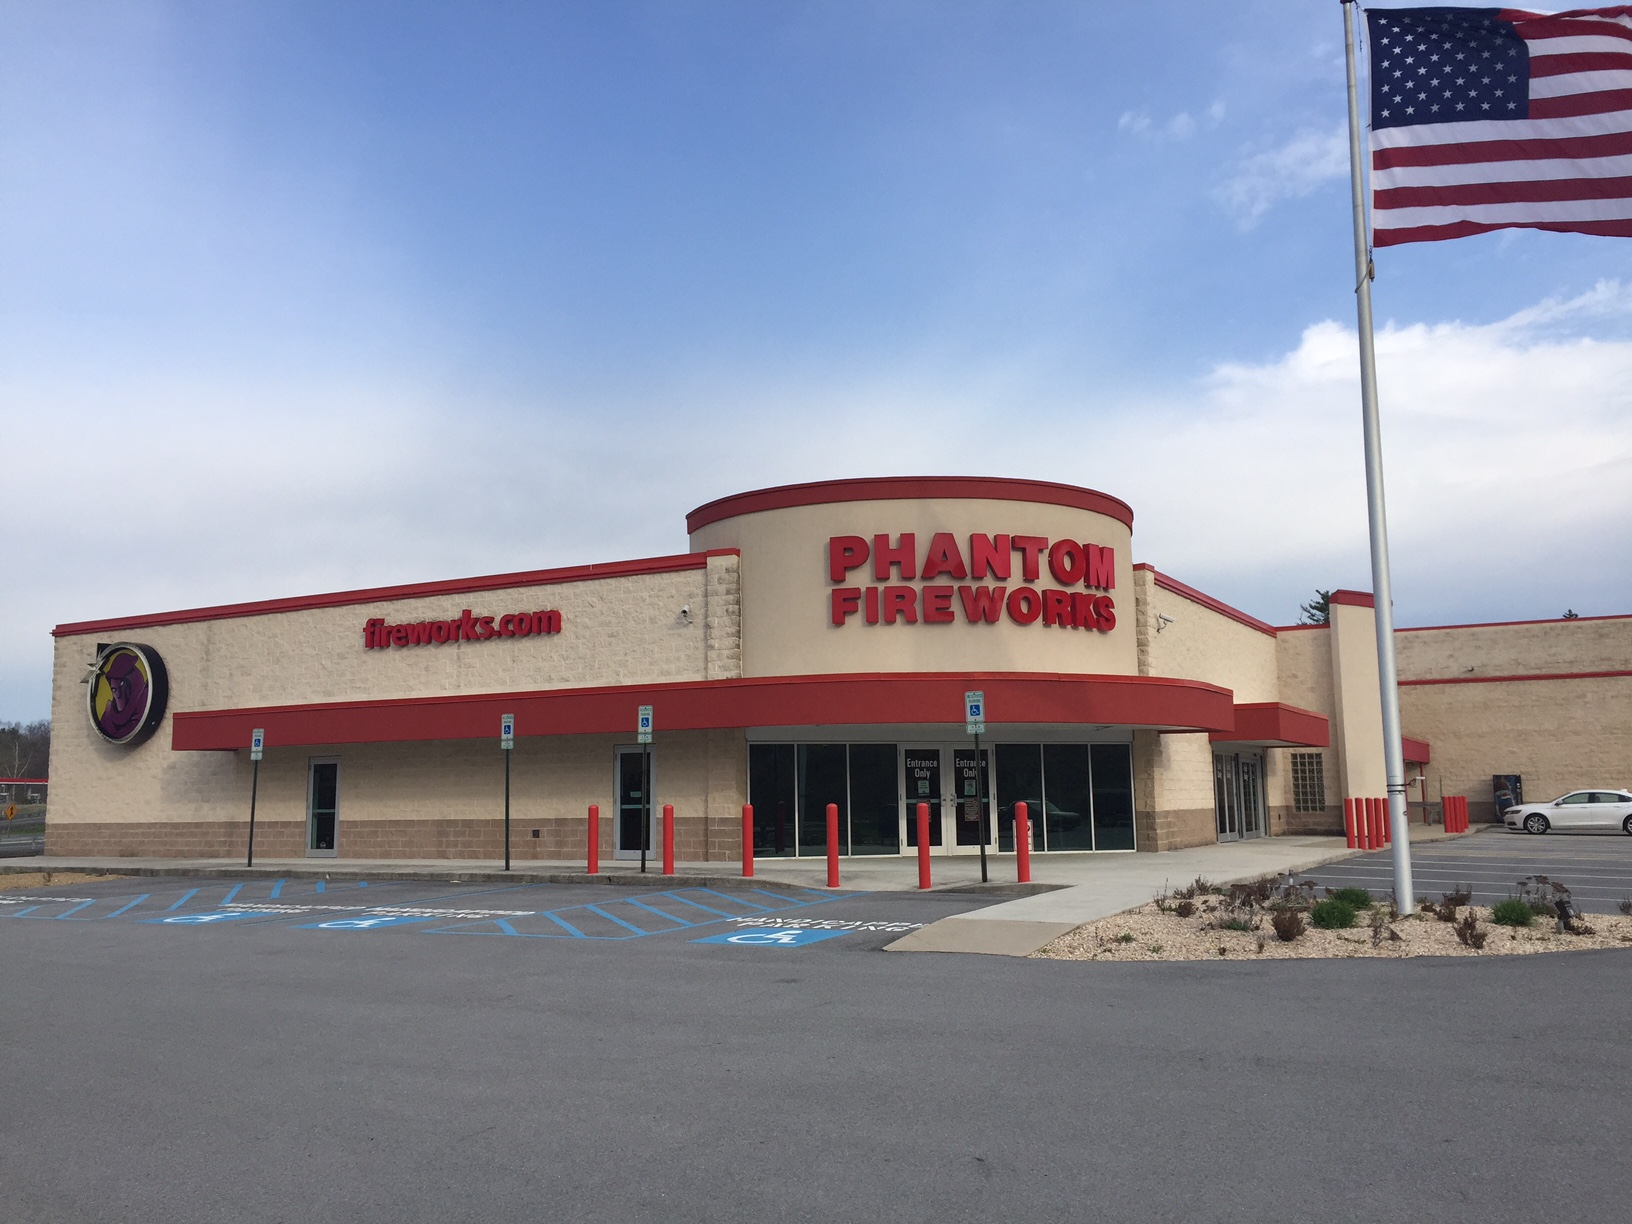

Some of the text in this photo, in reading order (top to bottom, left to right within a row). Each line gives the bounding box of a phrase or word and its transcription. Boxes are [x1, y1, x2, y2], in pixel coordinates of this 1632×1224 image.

[829, 532, 1116, 590] PHANTOM
[831, 585, 1117, 632] FIREWORKS
[363, 609, 562, 649] fireworks.com
[906, 758, 938, 768] Entrance
[914, 768, 931, 780] Only
